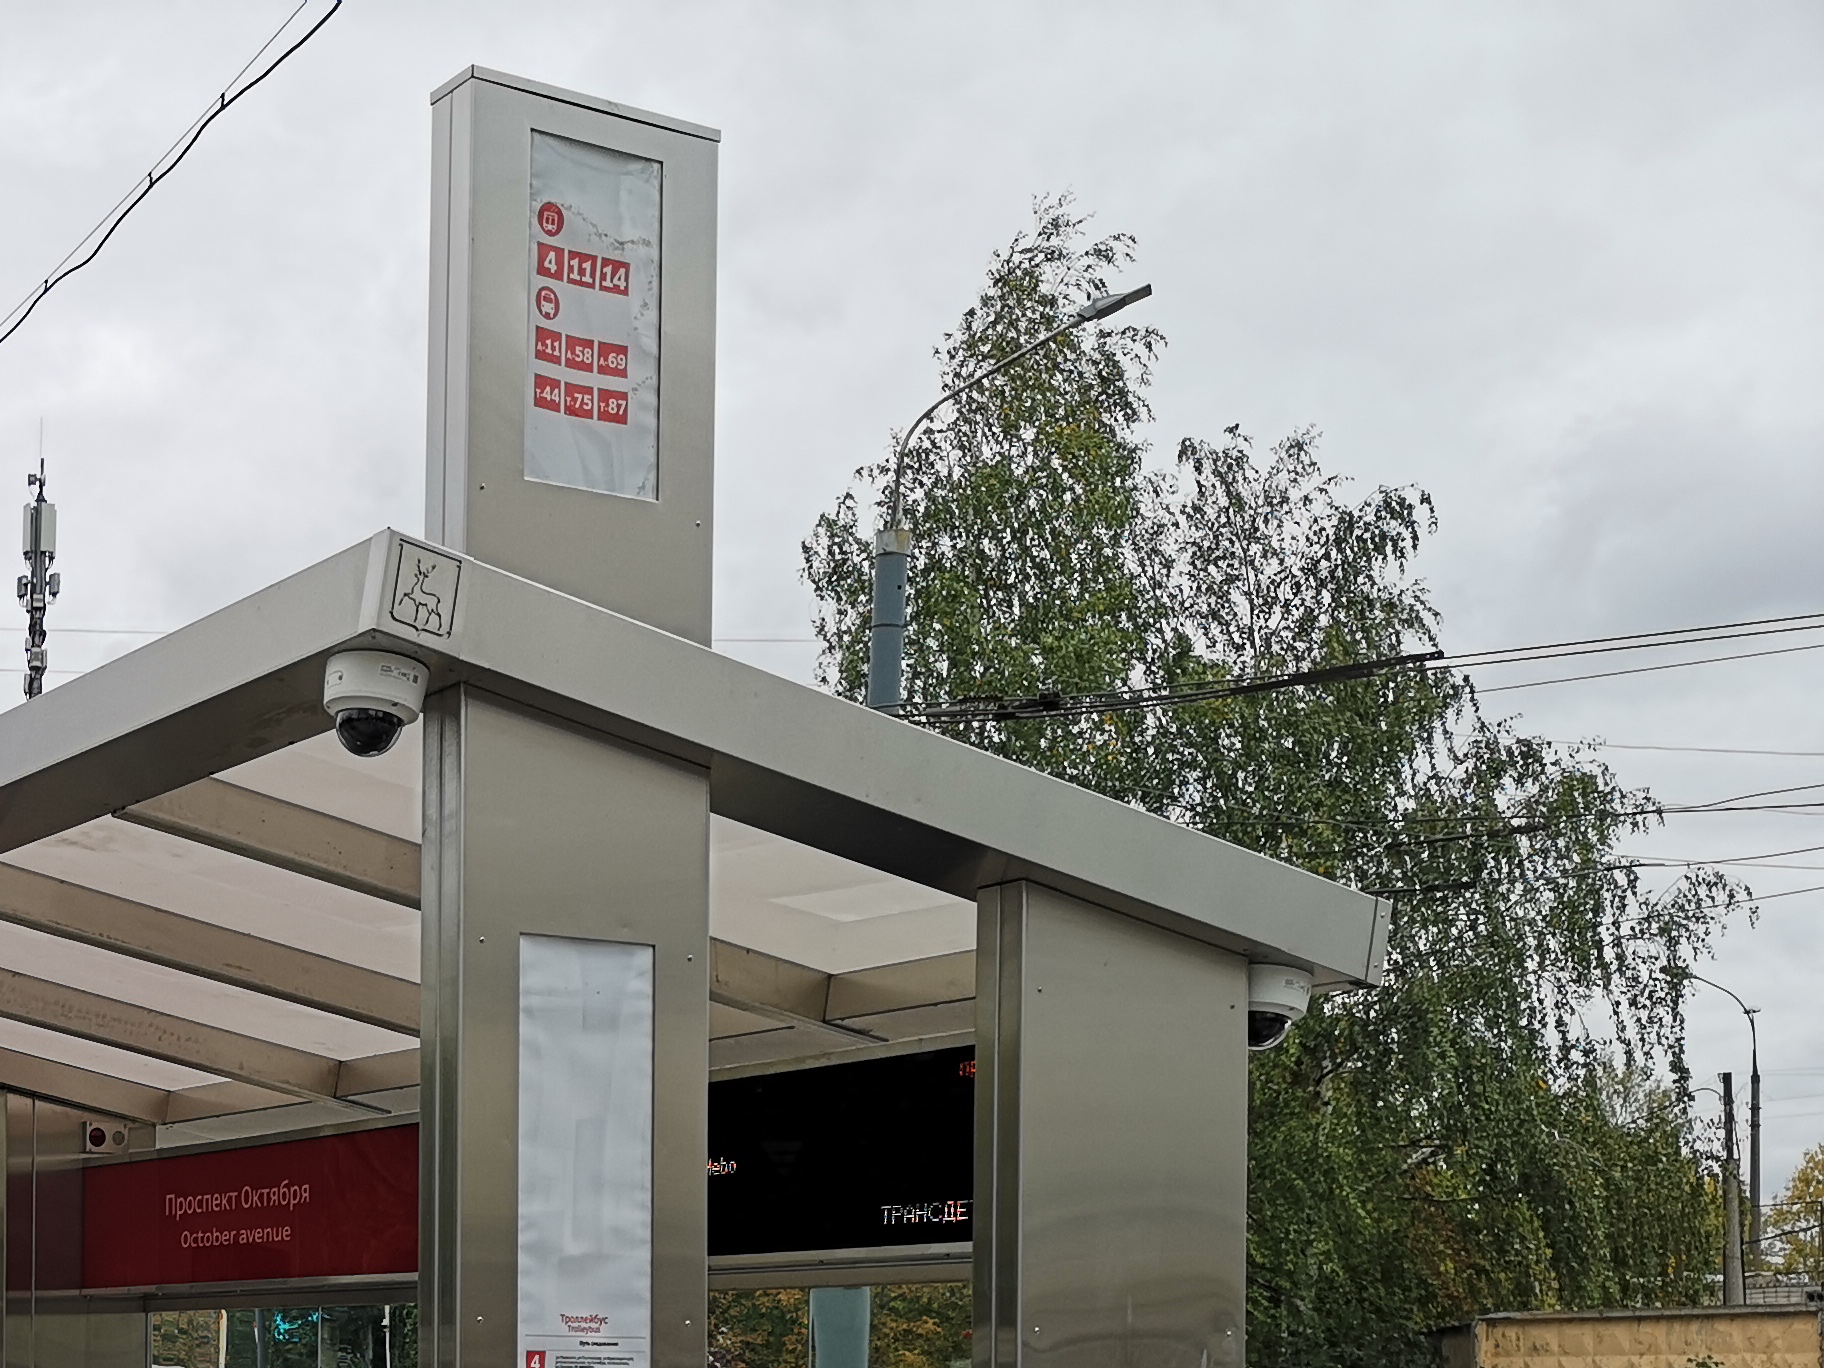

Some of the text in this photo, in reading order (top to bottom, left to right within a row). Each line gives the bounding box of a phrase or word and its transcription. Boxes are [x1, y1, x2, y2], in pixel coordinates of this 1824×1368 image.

[543, 250, 627, 290] 4 11 14
[165, 1179, 310, 1221] Проспект Октября
[881, 1199, 974, 1225] ТРАНСДЕ
[180, 1225, 292, 1248] October avenue
